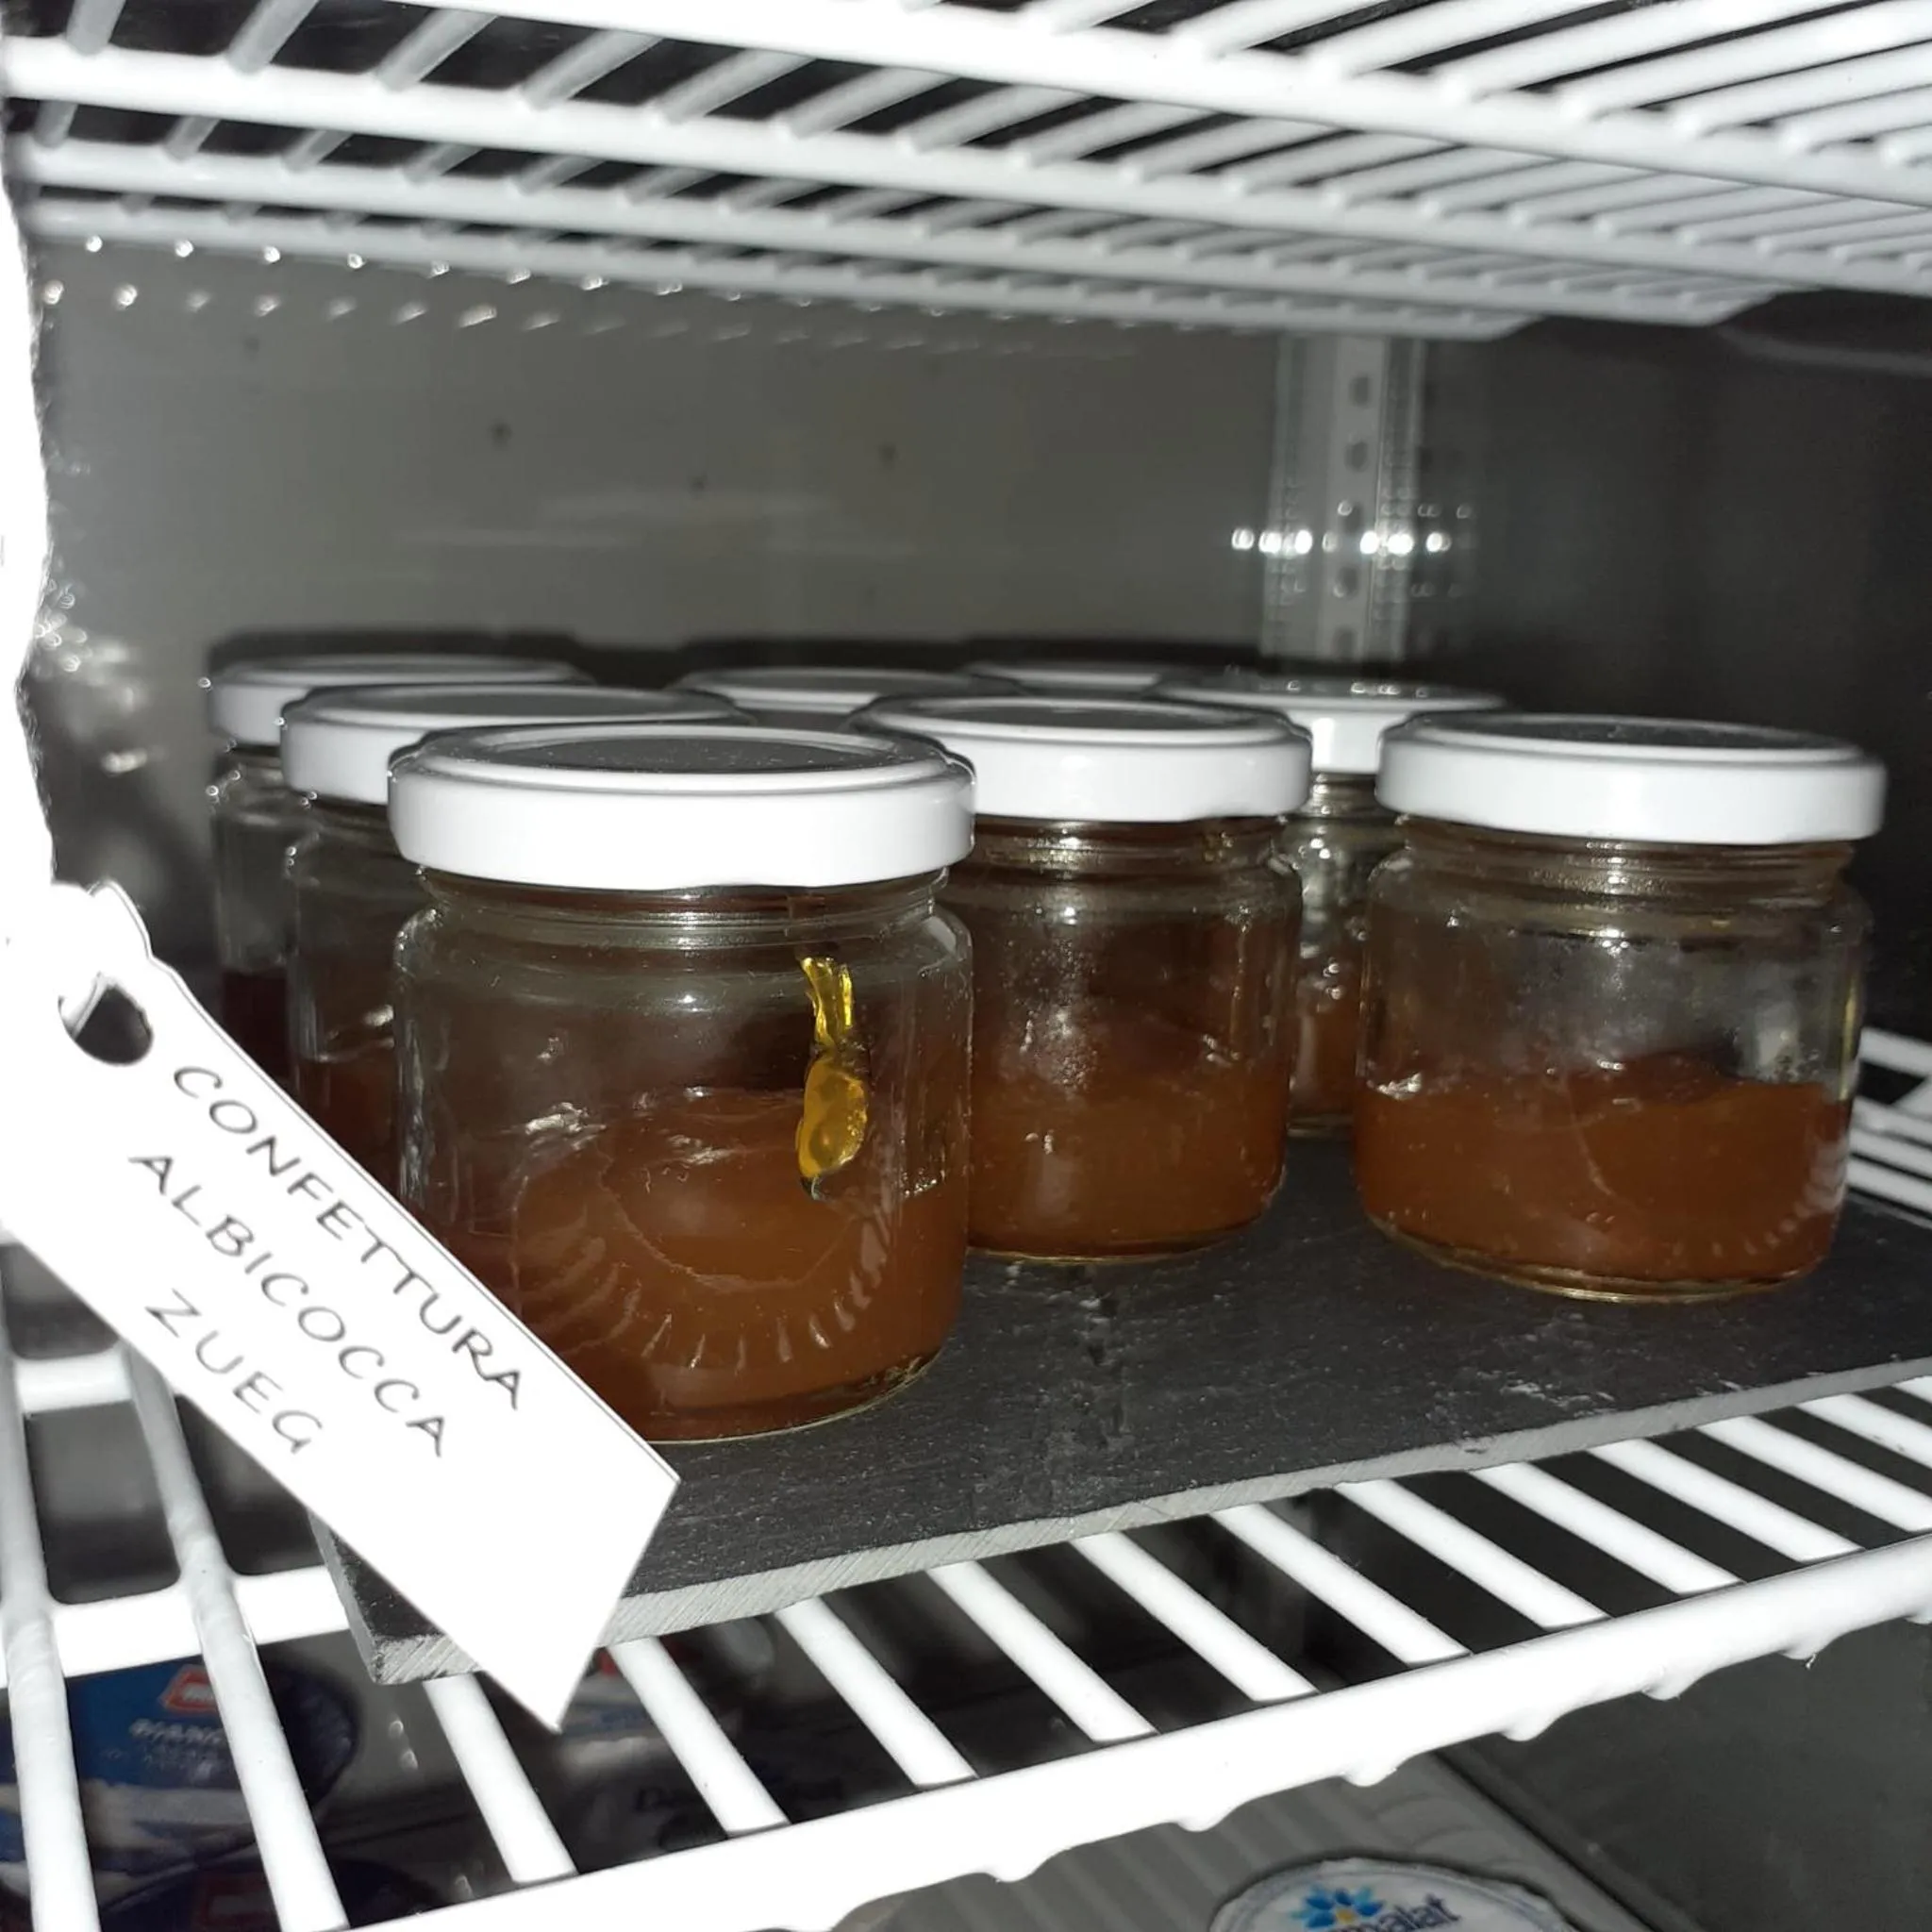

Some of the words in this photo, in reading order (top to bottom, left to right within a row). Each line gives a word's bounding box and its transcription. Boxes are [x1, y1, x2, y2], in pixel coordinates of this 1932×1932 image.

[129, 1156, 445, 1457] ALBICOCCA
[144, 1290, 323, 1454] ZUEG
[174, 1067, 521, 1409] CONFETTURA
